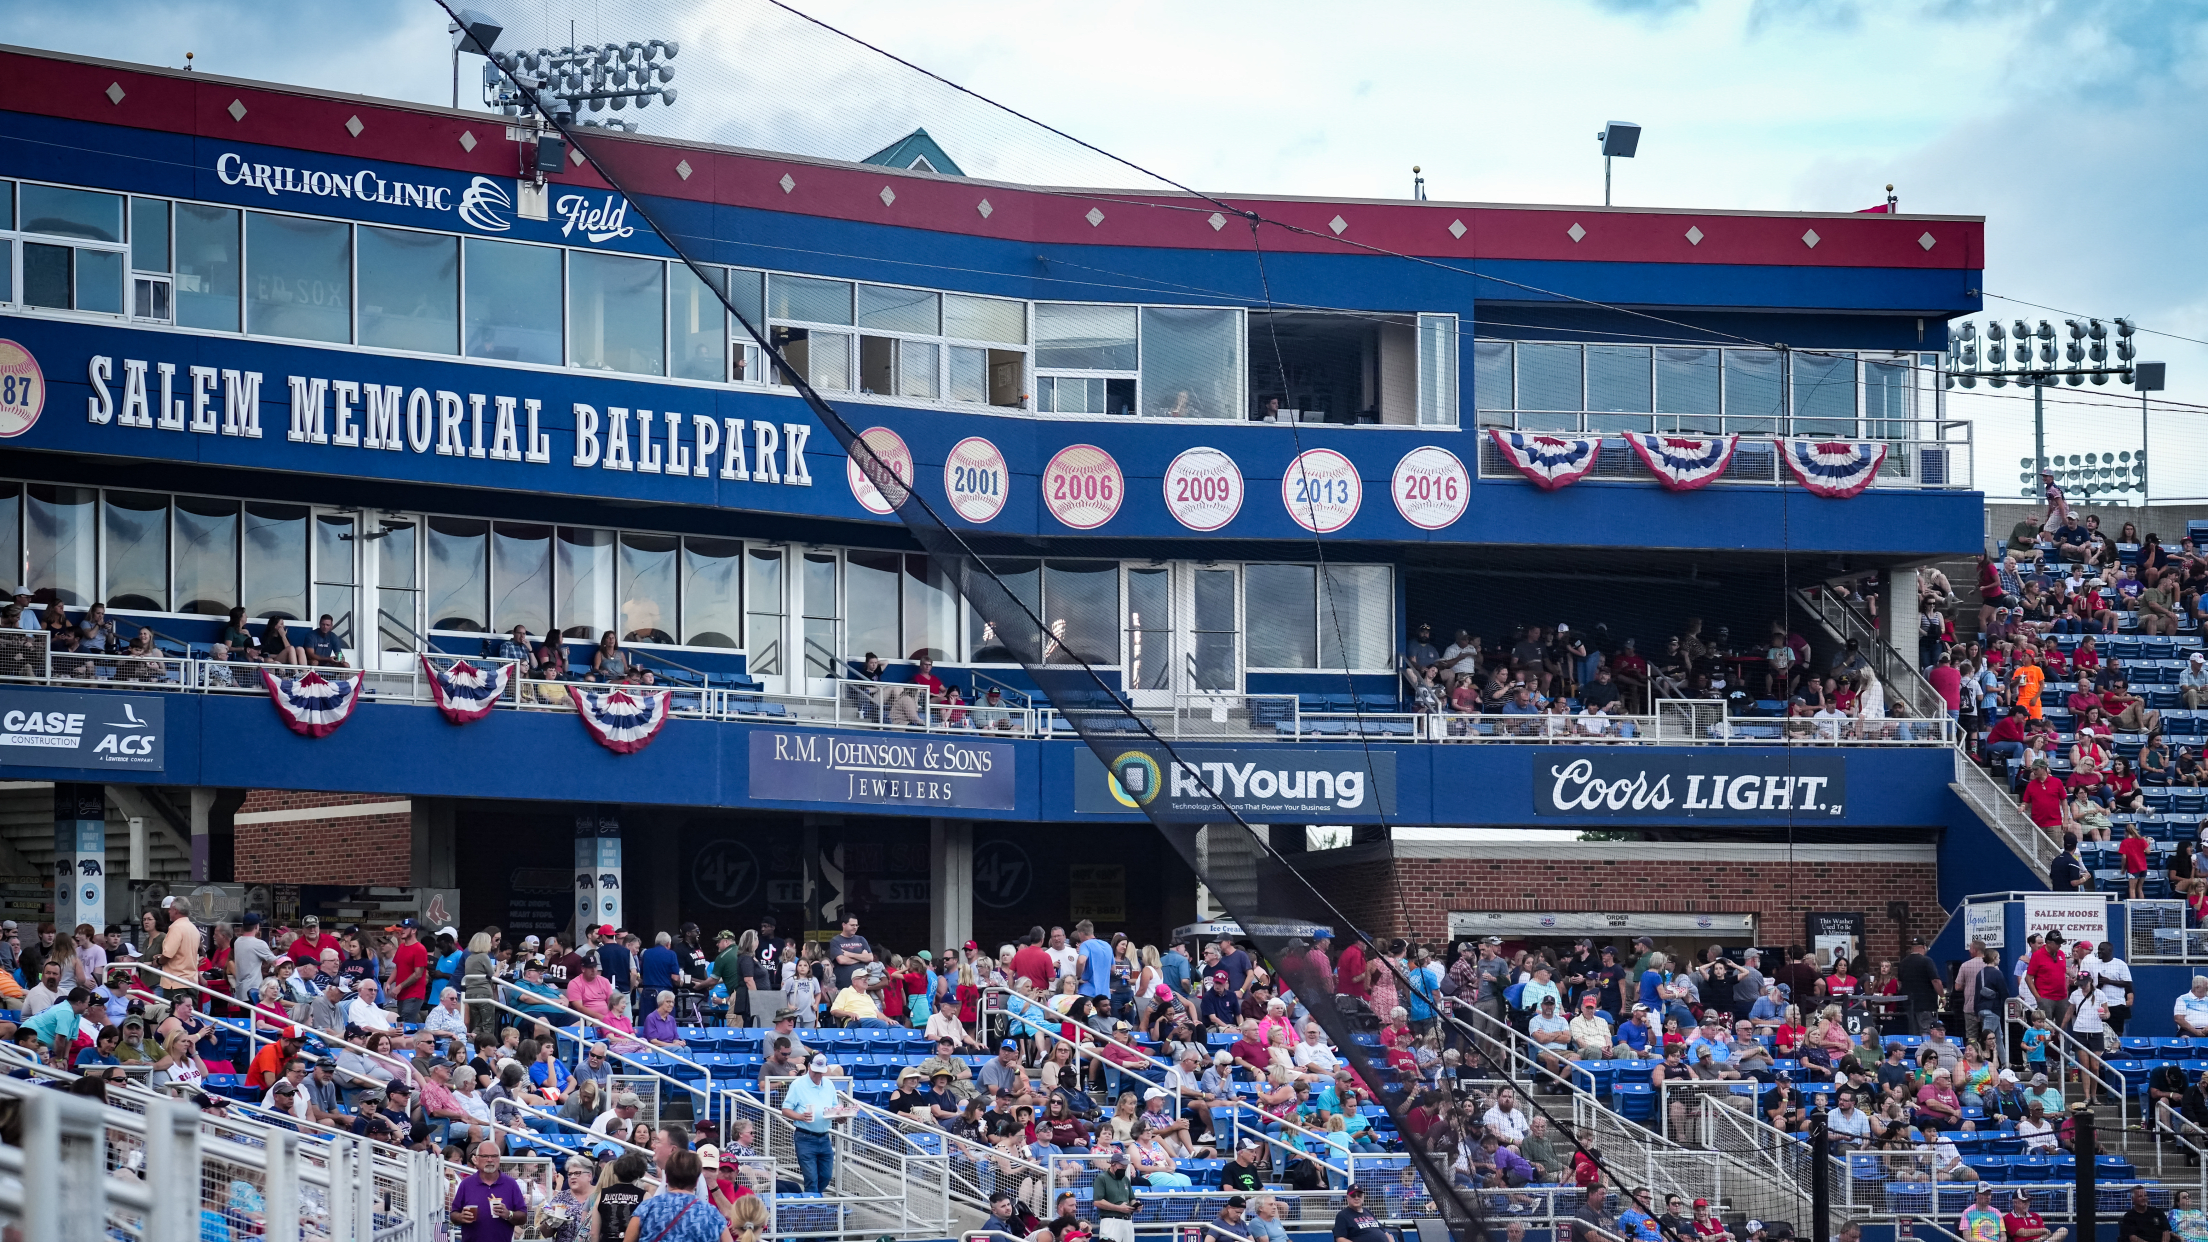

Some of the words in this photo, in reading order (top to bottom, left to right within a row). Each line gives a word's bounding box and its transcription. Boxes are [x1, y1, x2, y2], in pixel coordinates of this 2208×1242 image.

[556, 193, 634, 243] Field
[3, 375, 31, 407] 87
[88, 355, 264, 439] SALEM
[288, 375, 550, 465] MEMORIAL
[573, 403, 812, 487] BALLPARK
[954, 466, 999, 496] 2001
[1053, 474, 1113, 501] 2006
[1177, 476, 1230, 503] 2009
[1296, 477, 1349, 504] 2013
[1405, 475, 1458, 501] 2016
[4, 710, 86, 734] CASE
[11, 735, 77, 746] CONSTRUCTION
[92, 734, 156, 754] ACS
[774, 734, 821, 763] R.M.
[826, 737, 917, 770] JOHNSON
[923, 743, 940, 769] &
[944, 744, 992, 772] SONS
[848, 774, 952, 800] JEWELERS
[1170, 762, 1364, 809] RJYoung
[1550, 758, 1674, 811] Coors
[1172, 802, 1210, 811] Technology
[2034, 910, 2066, 918] SALEM
[2067, 910, 2098, 918] MOOSE
[2066, 924, 2104, 932] CENTER
